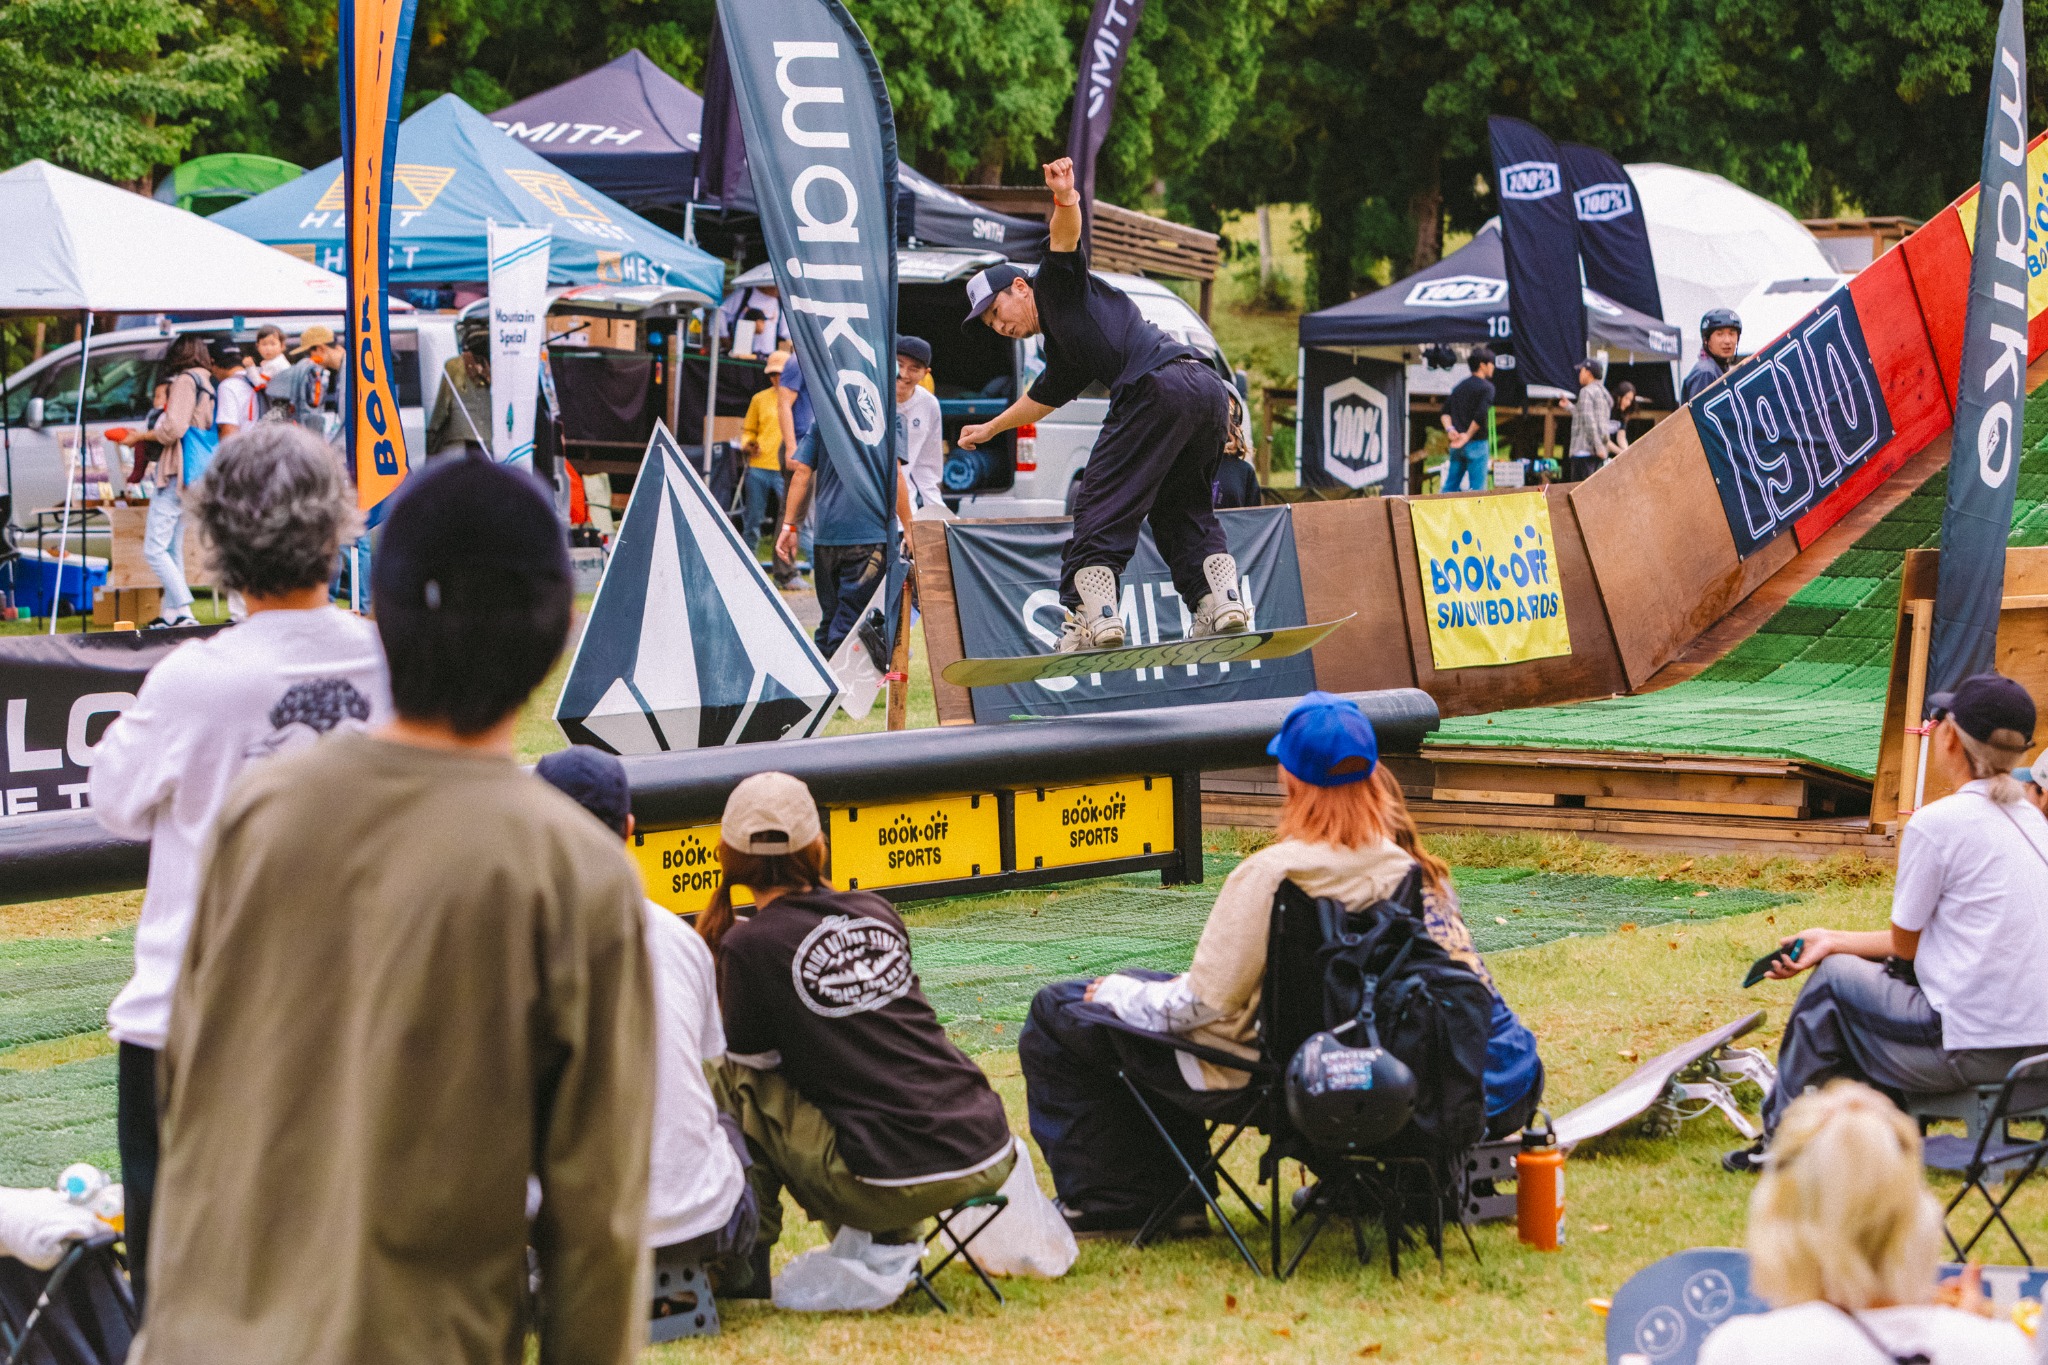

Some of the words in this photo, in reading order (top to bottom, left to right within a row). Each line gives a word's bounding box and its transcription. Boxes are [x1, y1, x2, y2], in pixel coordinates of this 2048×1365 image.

[1088, 0, 1135, 119] SMIT
[1508, 170, 1553, 192] 100%
[1582, 190, 1625, 213] 100%
[973, 217, 1005, 243] SMITH
[623, 256, 672, 286] HEST
[1333, 404, 1380, 464] 100%
[1703, 304, 1879, 540] 1910
[1437, 592, 1558, 629] SNOWBOARDS
[1069, 826, 1118, 848] SPORTS
[888, 847, 942, 869] SPORTS
[672, 869, 722, 893] SPORT
